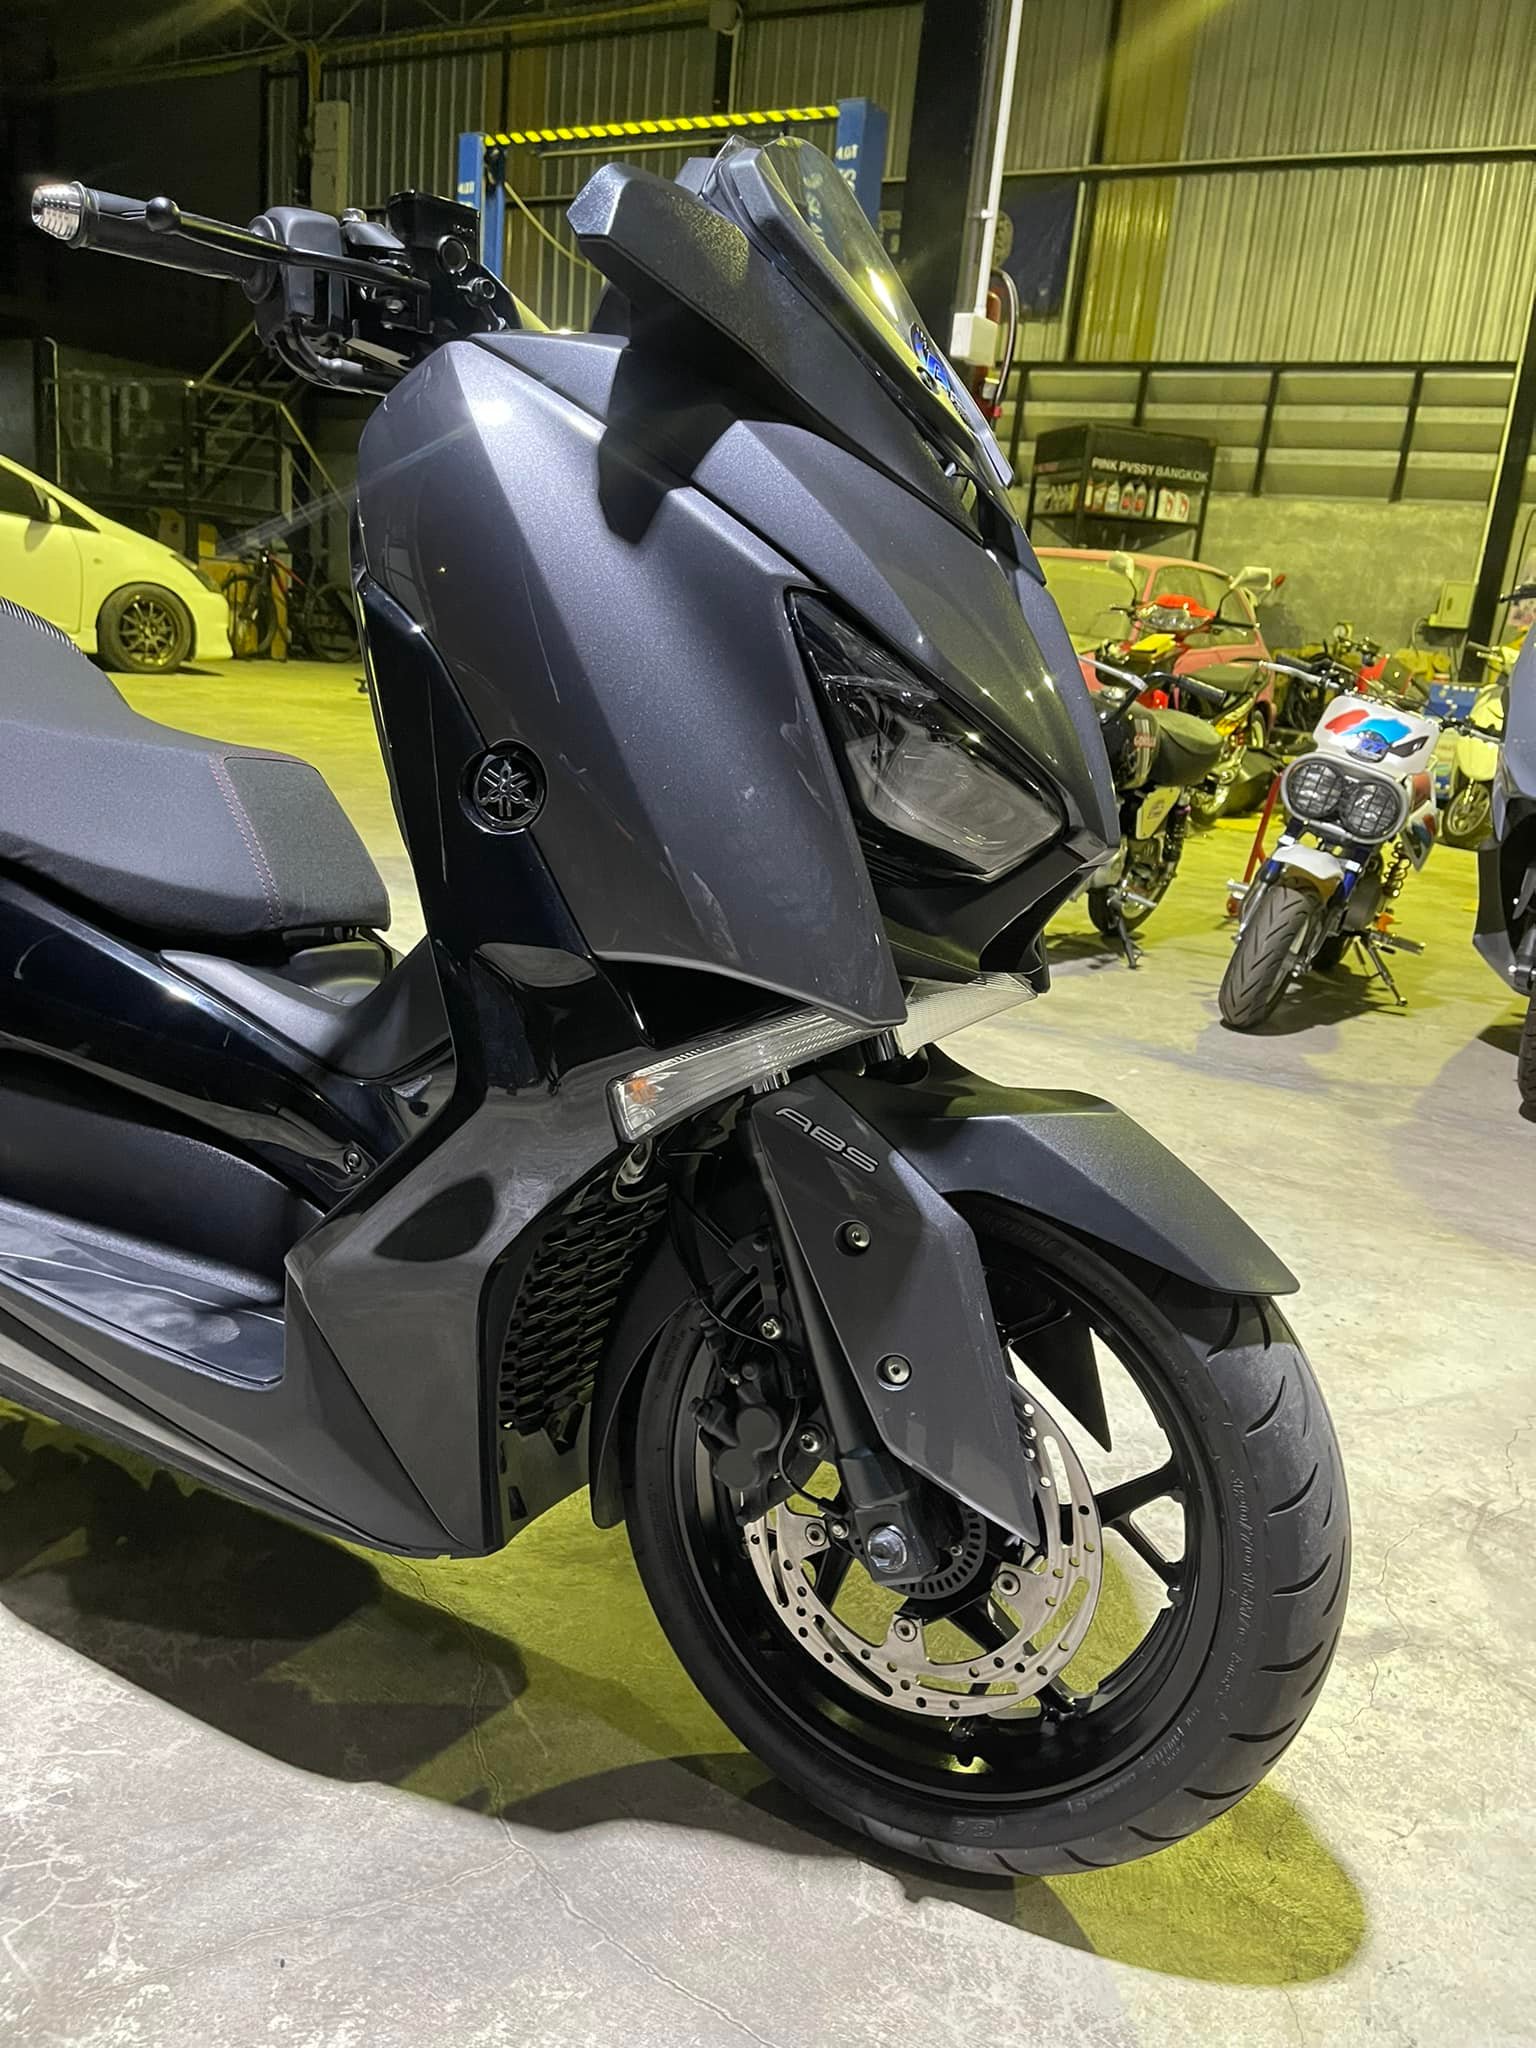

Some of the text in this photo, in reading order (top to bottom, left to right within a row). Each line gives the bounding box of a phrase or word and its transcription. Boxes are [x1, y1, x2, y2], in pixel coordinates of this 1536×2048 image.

[1091, 457, 1118, 471] PINK
[1155, 465, 1208, 482] BANGKOK
[775, 1106, 879, 1173] ABS
